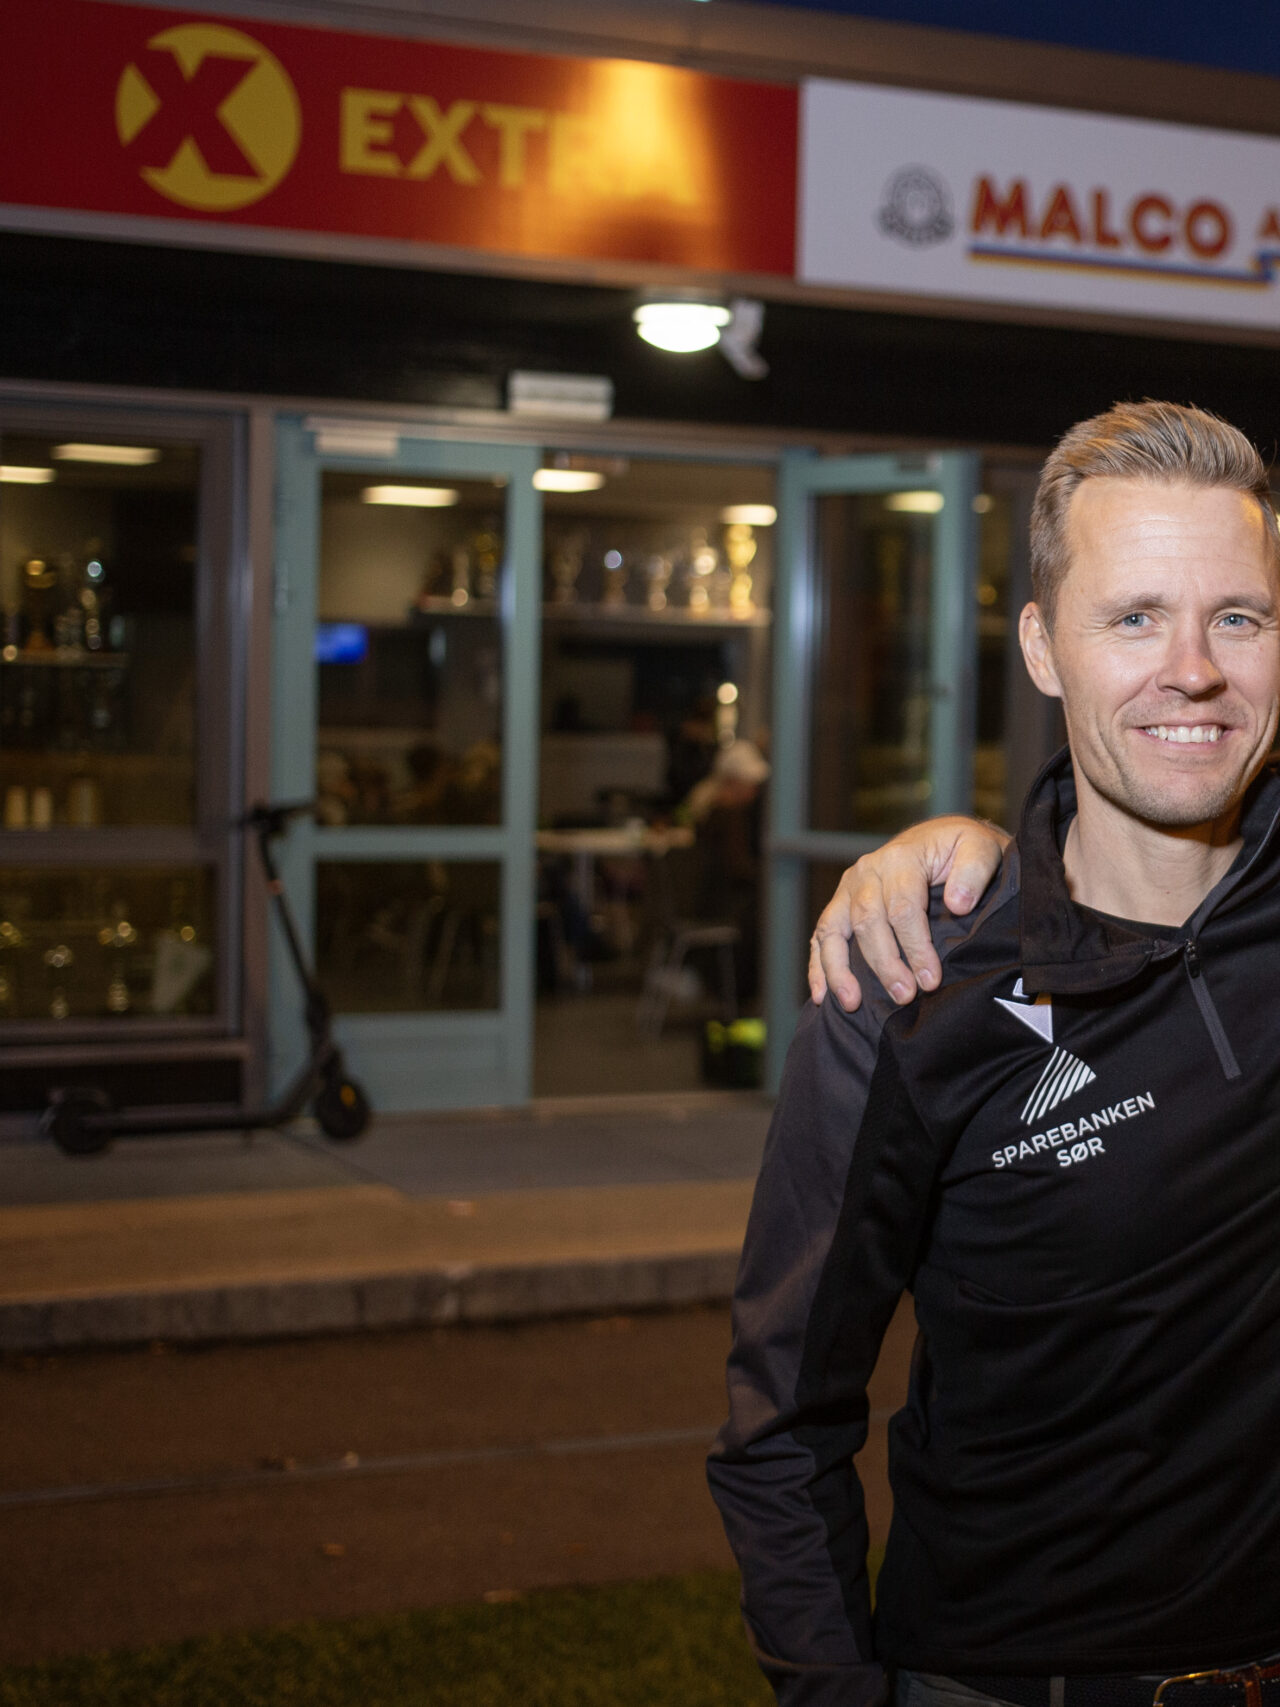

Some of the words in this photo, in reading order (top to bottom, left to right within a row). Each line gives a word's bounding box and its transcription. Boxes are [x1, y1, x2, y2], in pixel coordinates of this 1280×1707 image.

[341, 87, 698, 204] EXT
[971, 176, 1233, 259] MALCO
[991, 1091, 1156, 1168] SPAREBANKEN
[1056, 1136, 1106, 1167] SØR
